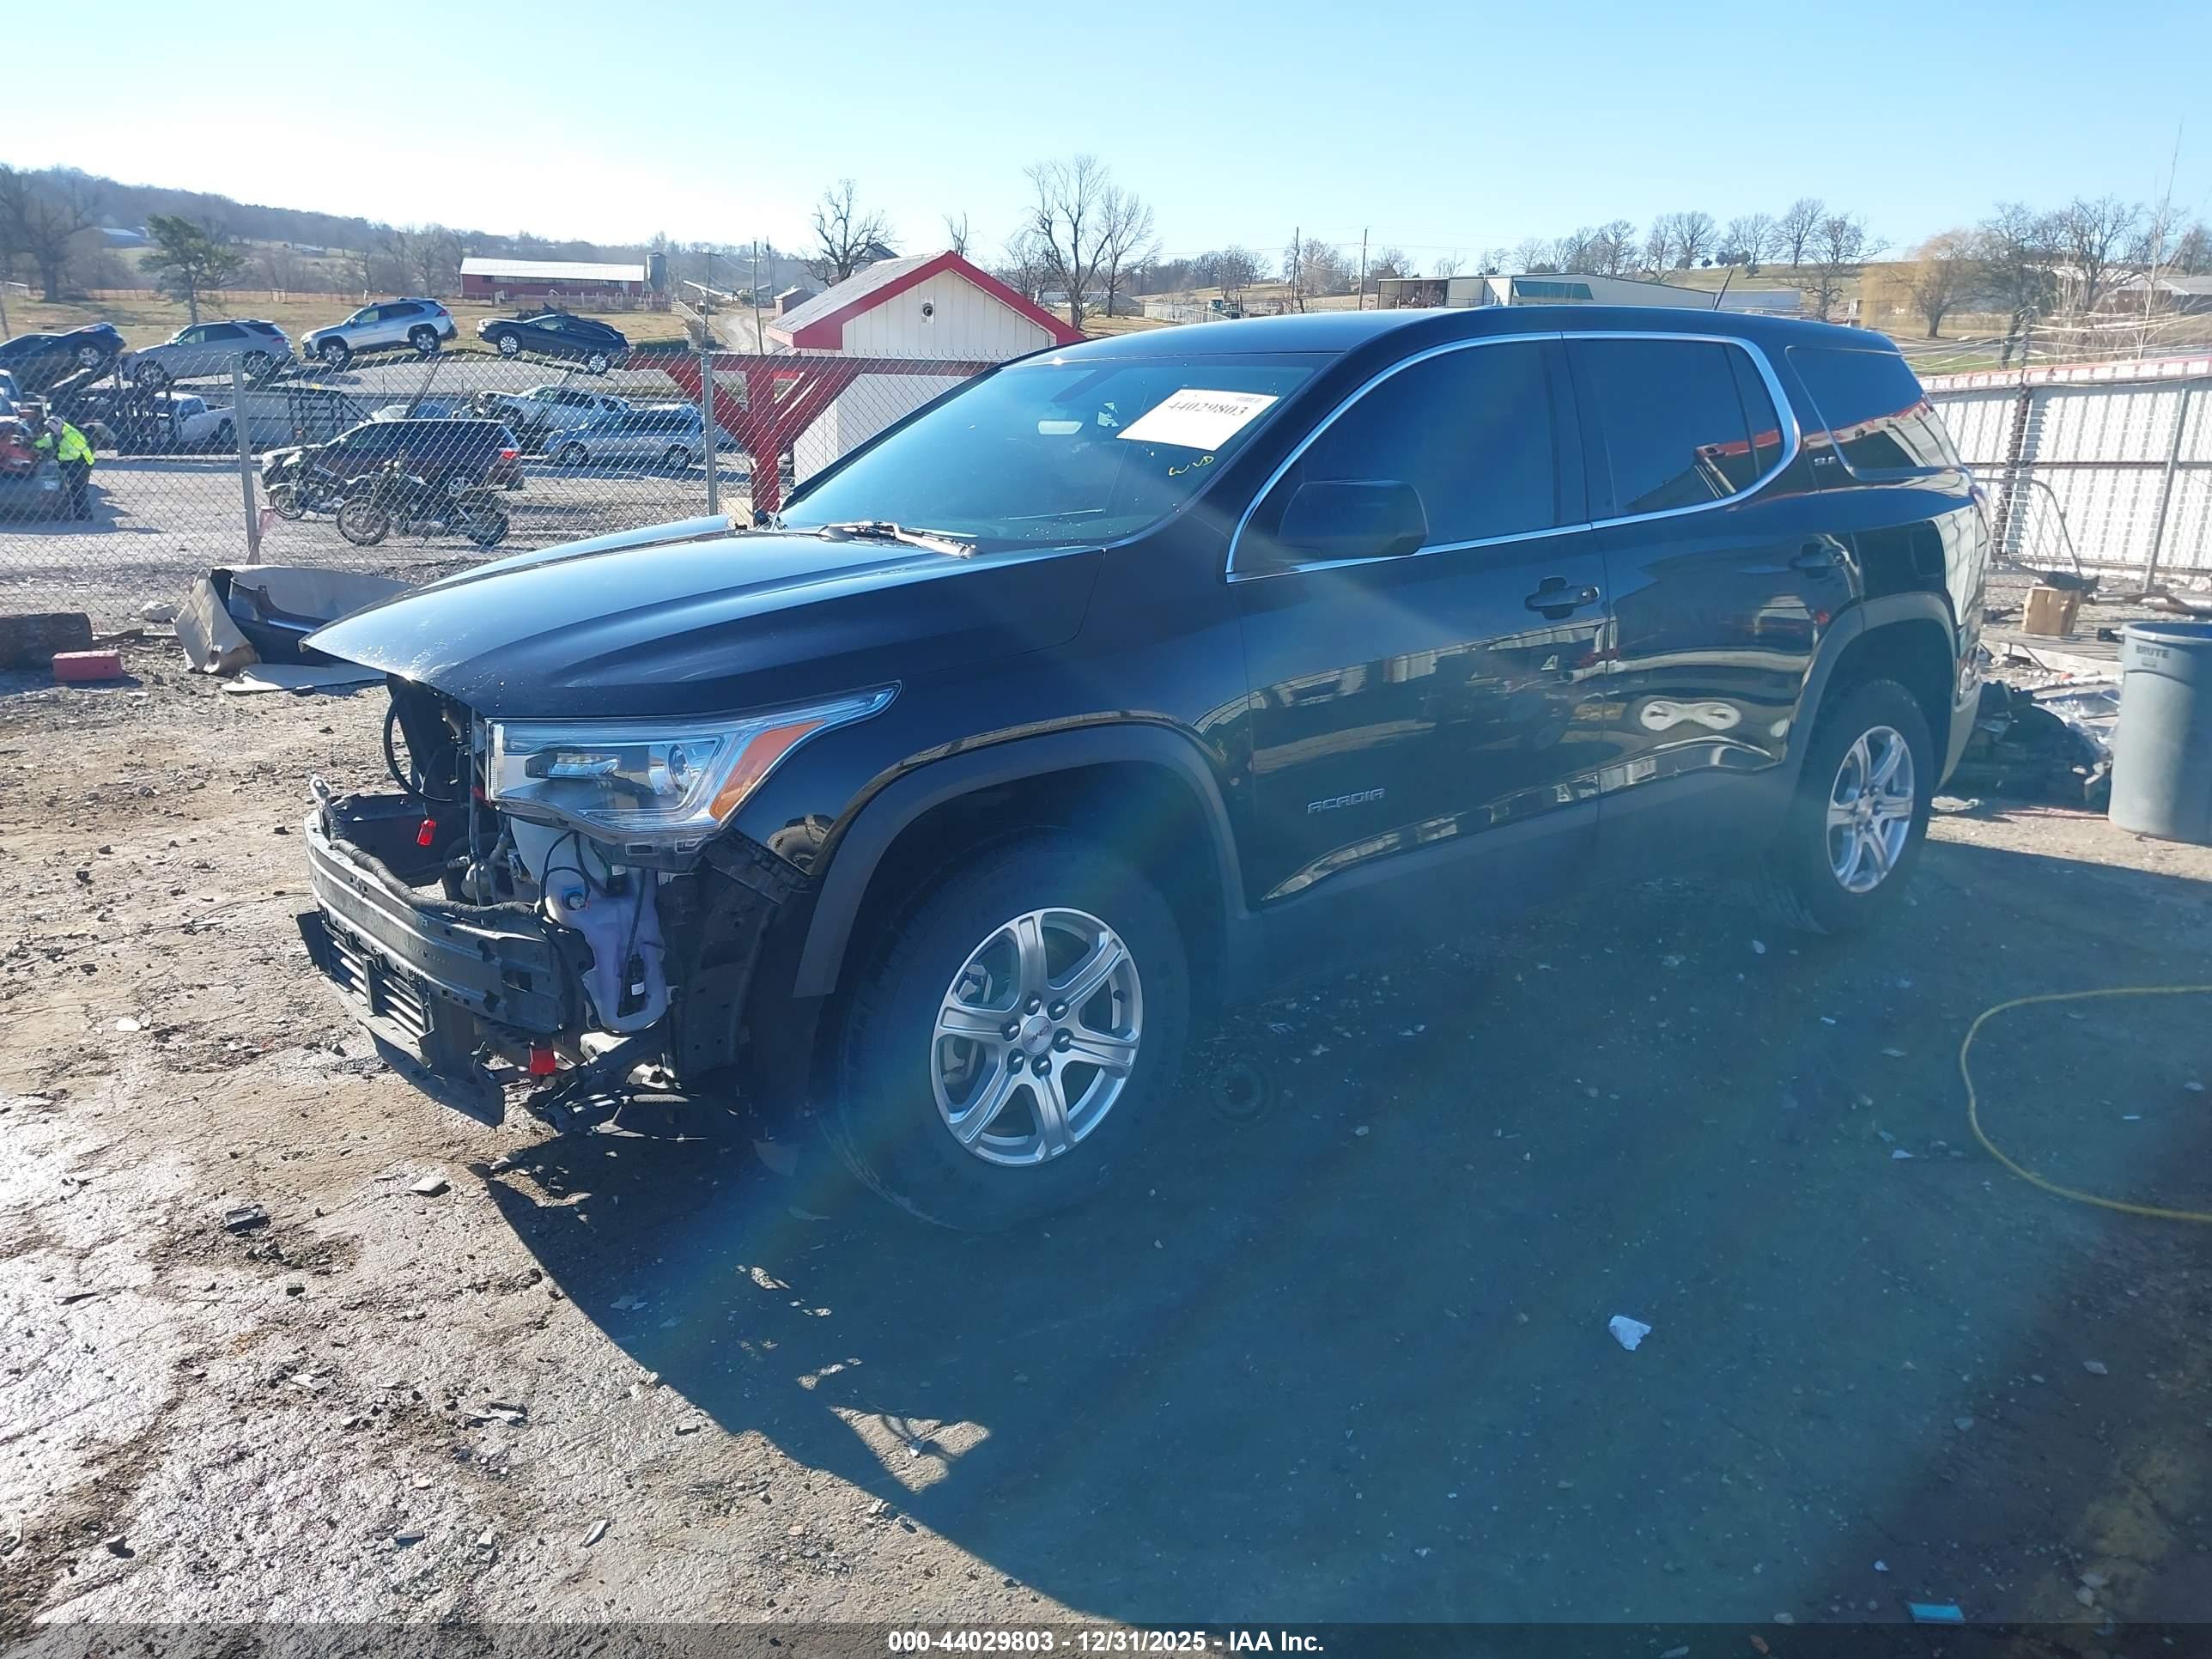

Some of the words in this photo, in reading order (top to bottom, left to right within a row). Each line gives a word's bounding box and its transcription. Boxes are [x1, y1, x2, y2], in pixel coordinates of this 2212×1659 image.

[1168, 401, 1249, 416] 44029803
[2135, 644, 2170, 659] BRUTE
[1307, 787, 1385, 815] ACADIA
[1023, 1022, 1051, 1046] GMC
